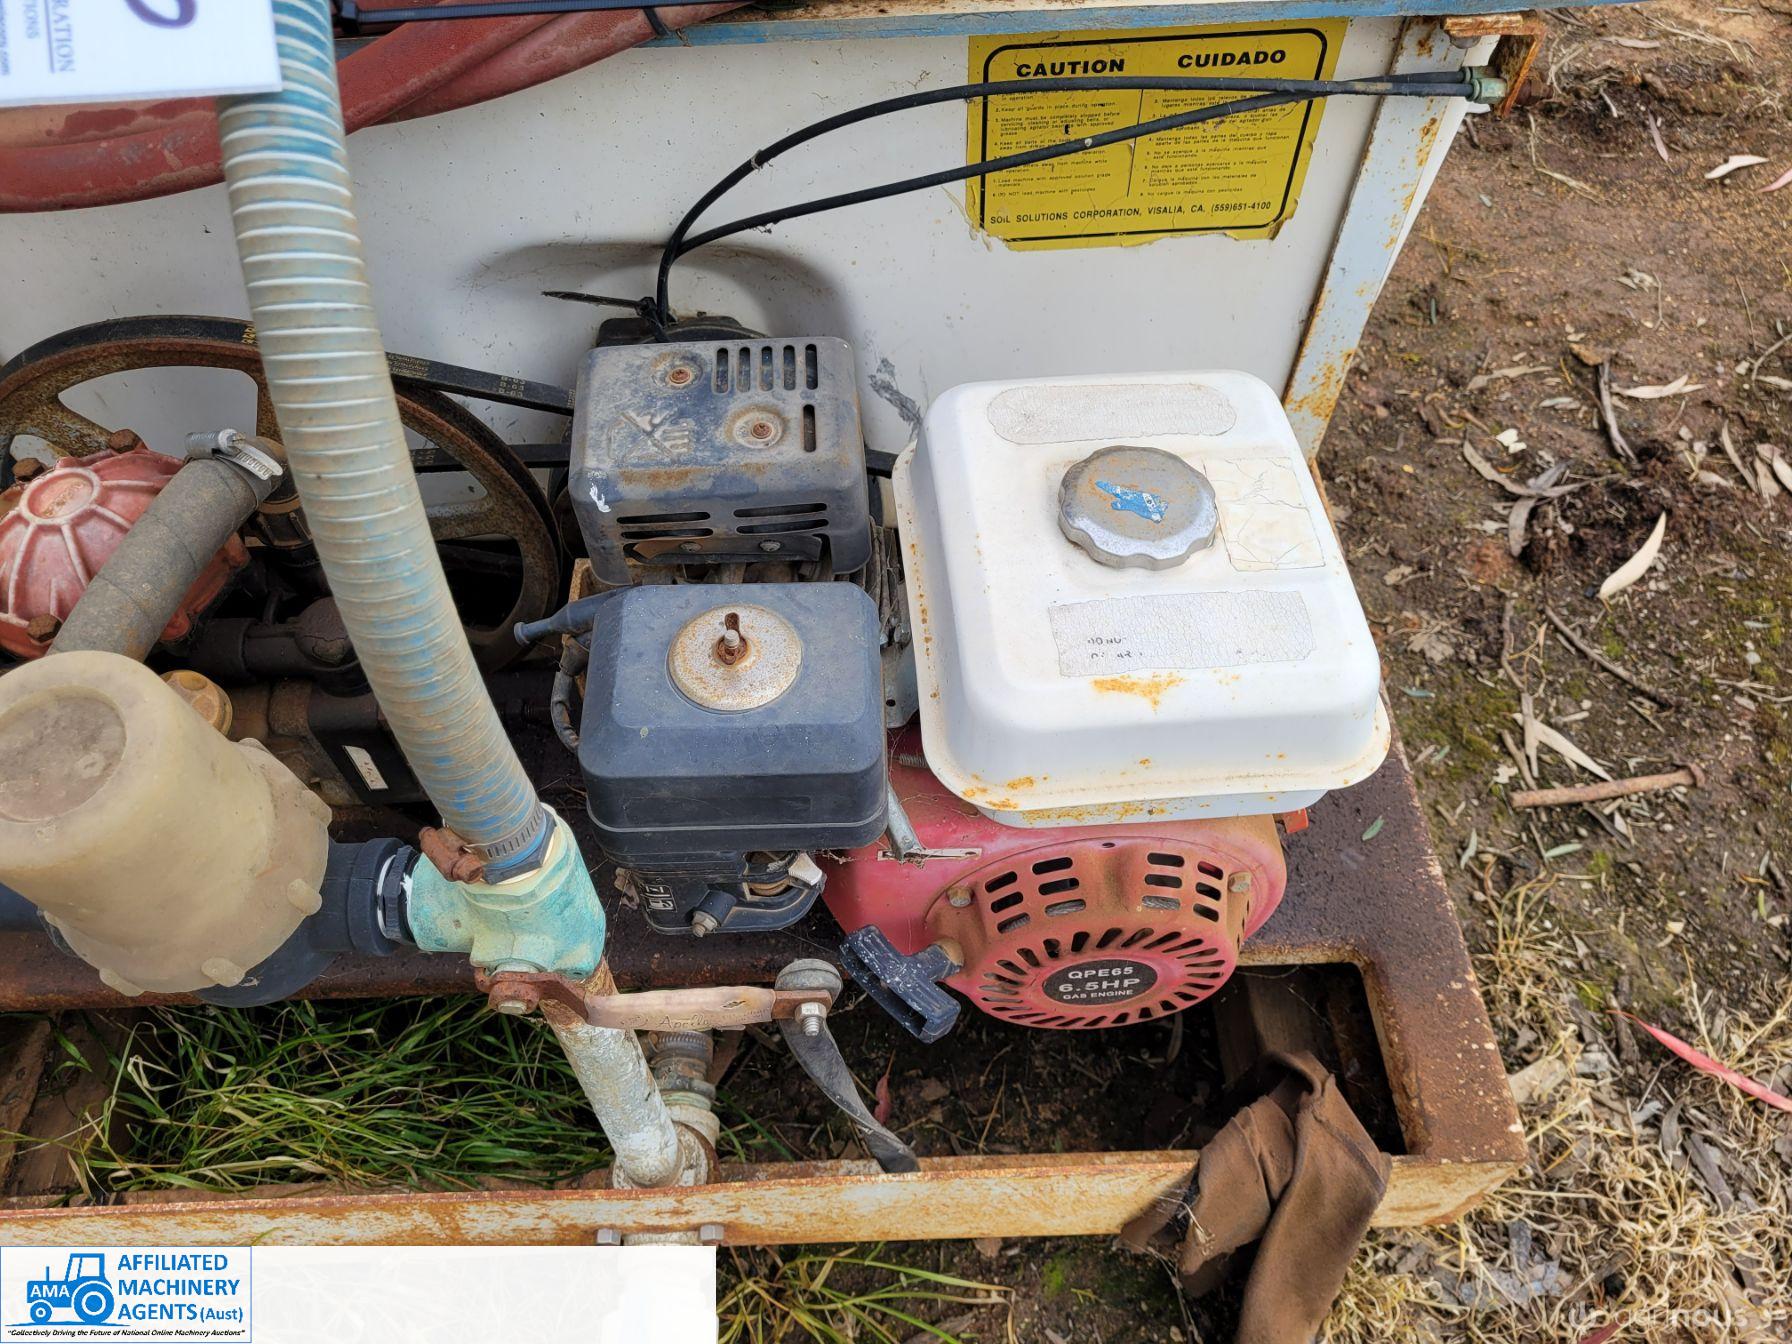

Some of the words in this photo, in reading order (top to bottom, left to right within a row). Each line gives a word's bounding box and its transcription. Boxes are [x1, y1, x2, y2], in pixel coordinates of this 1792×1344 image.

[1177, 50, 1286, 69] CUIDADO
[1016, 58, 1125, 78] CAUTION
[1016, 211, 1068, 223] SOLUTIONS
[1073, 207, 1142, 219] CORPORATION,
[1147, 204, 1185, 215] VISALIA,
[1190, 203, 1206, 213] CA.
[1211, 201, 1271, 214] (559)651-4100
[1068, 966, 1134, 979] QPE65
[1059, 978, 1140, 992] 6.5HP
[1090, 989, 1134, 998] ENGINE
